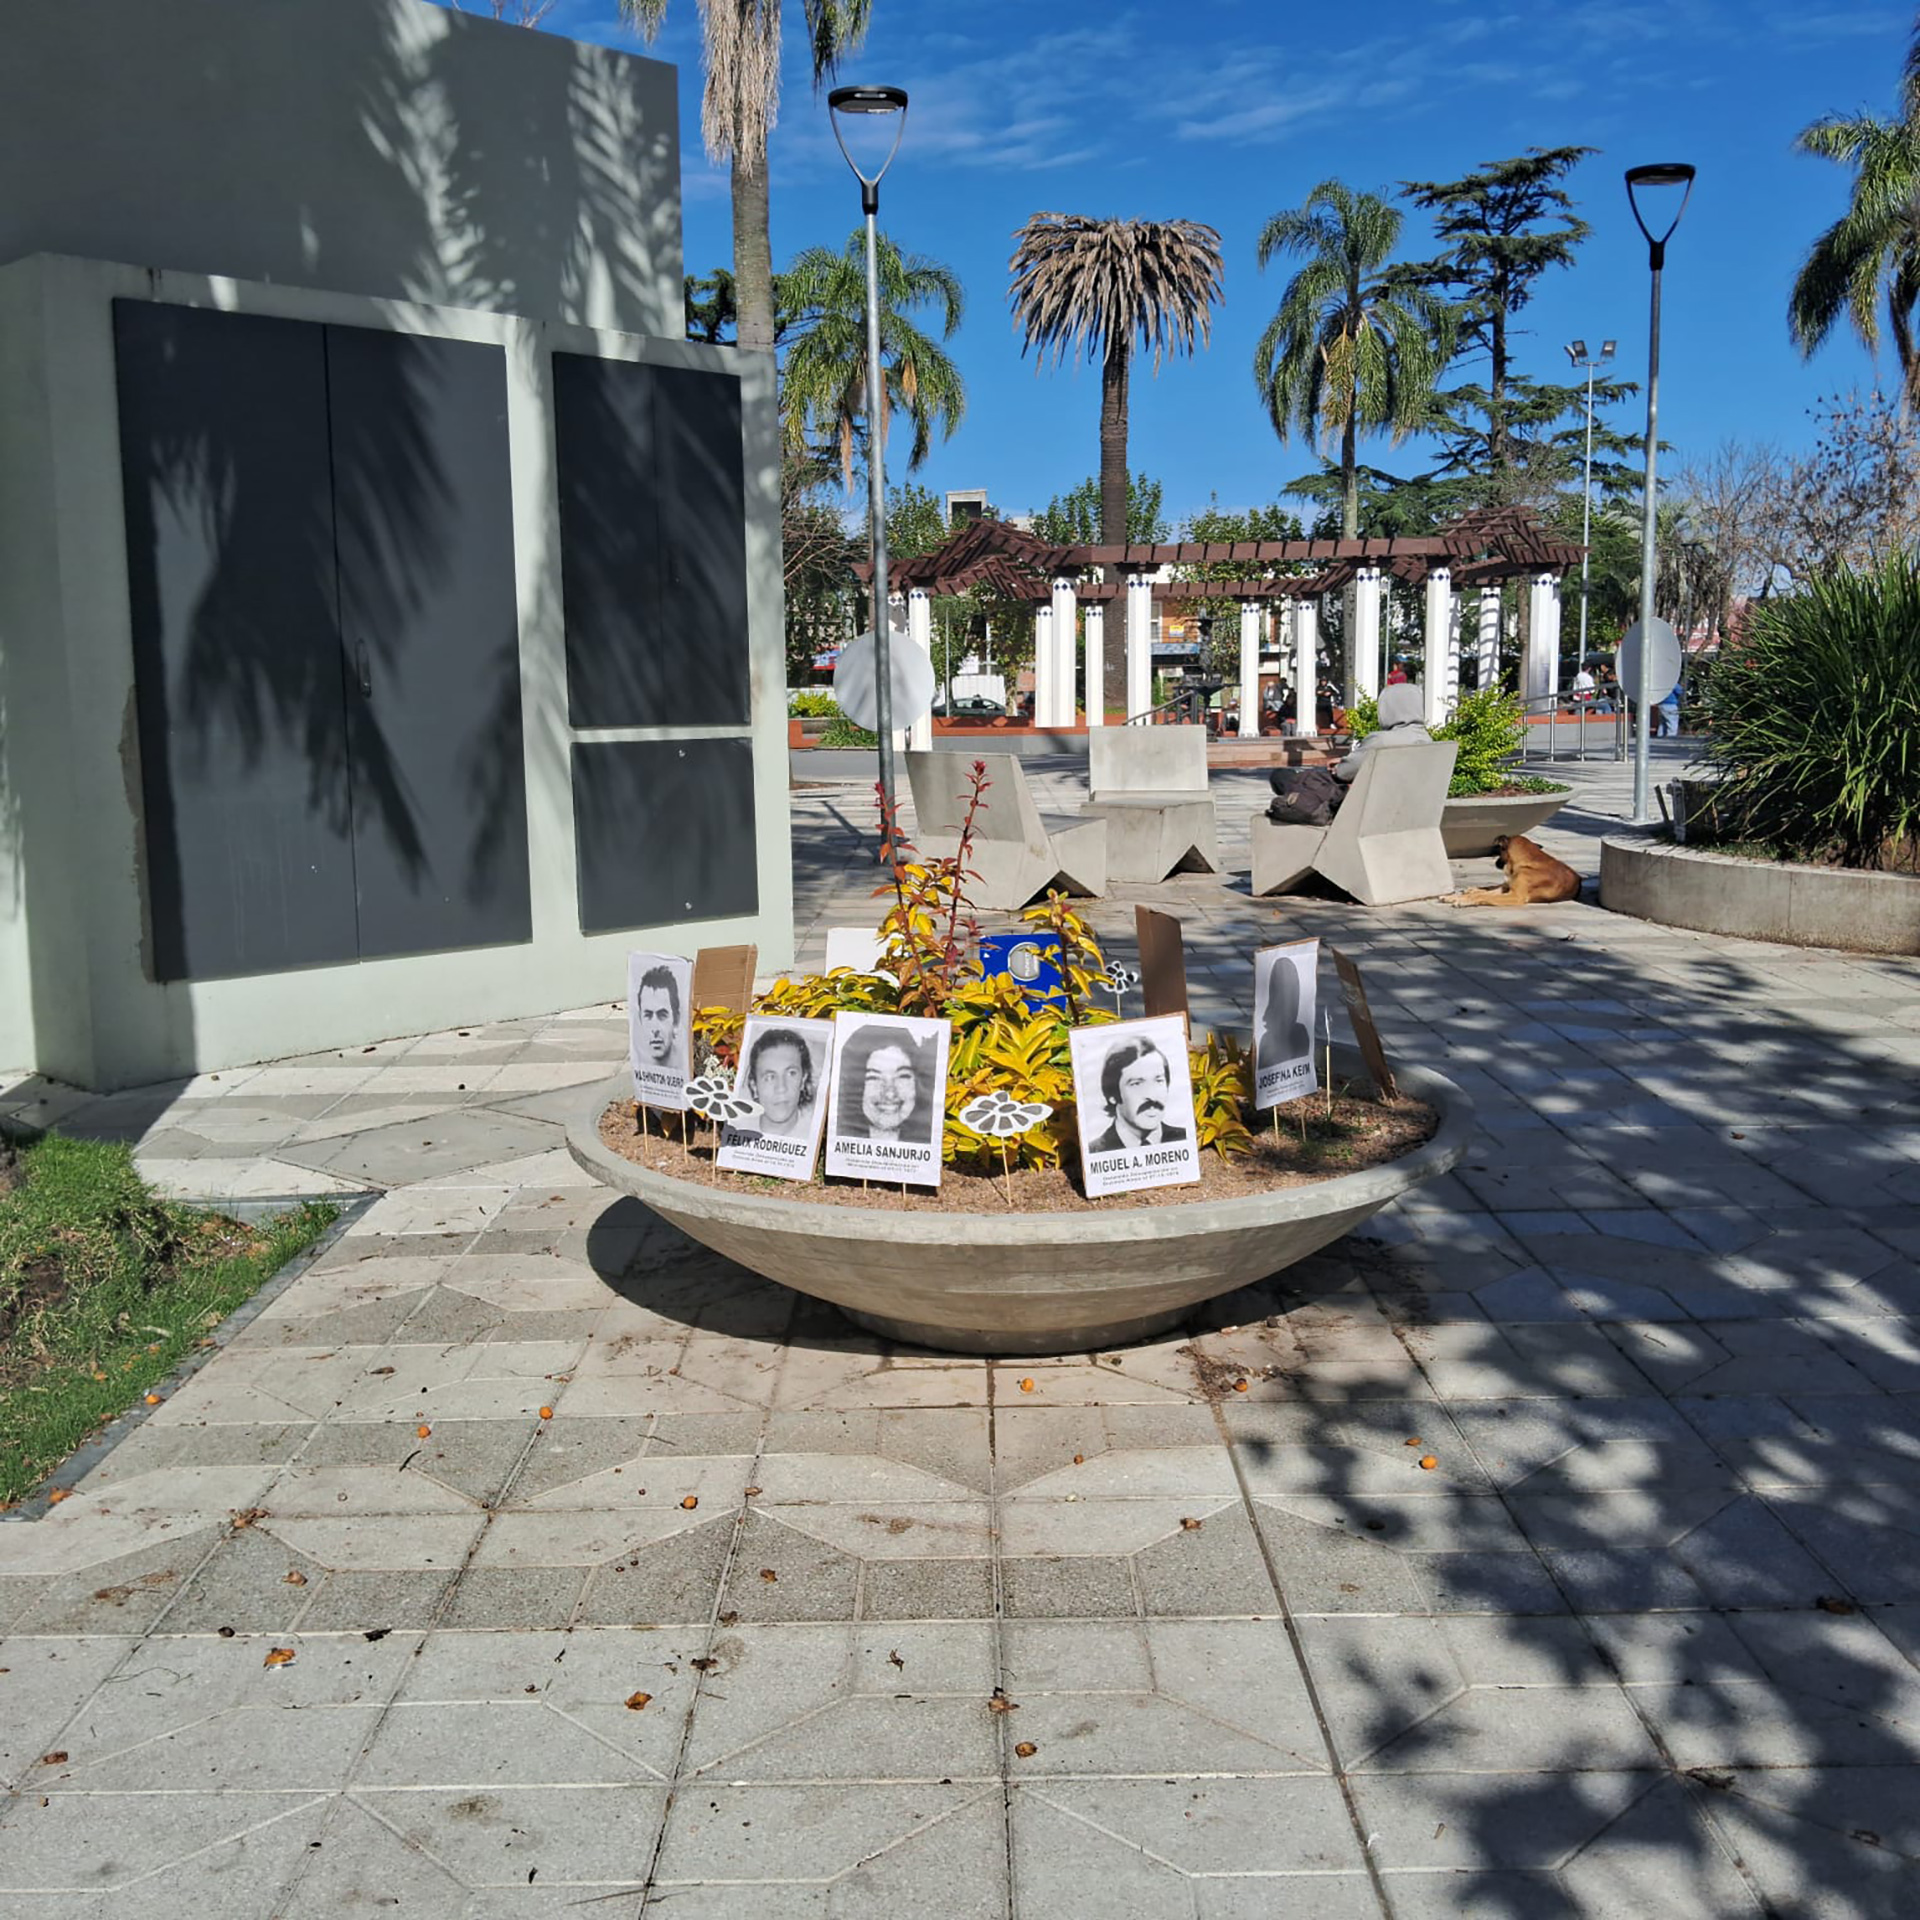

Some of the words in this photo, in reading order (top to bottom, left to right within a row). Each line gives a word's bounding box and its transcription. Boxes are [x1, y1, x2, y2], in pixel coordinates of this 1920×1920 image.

[834, 1142, 873, 1156] AMELIA
[875, 1145, 931, 1161] SANJURJO
[1090, 1158, 1129, 1174] MIGUEL
[1132, 1155, 1142, 1168] A.
[1145, 1148, 1190, 1166] MORENO
